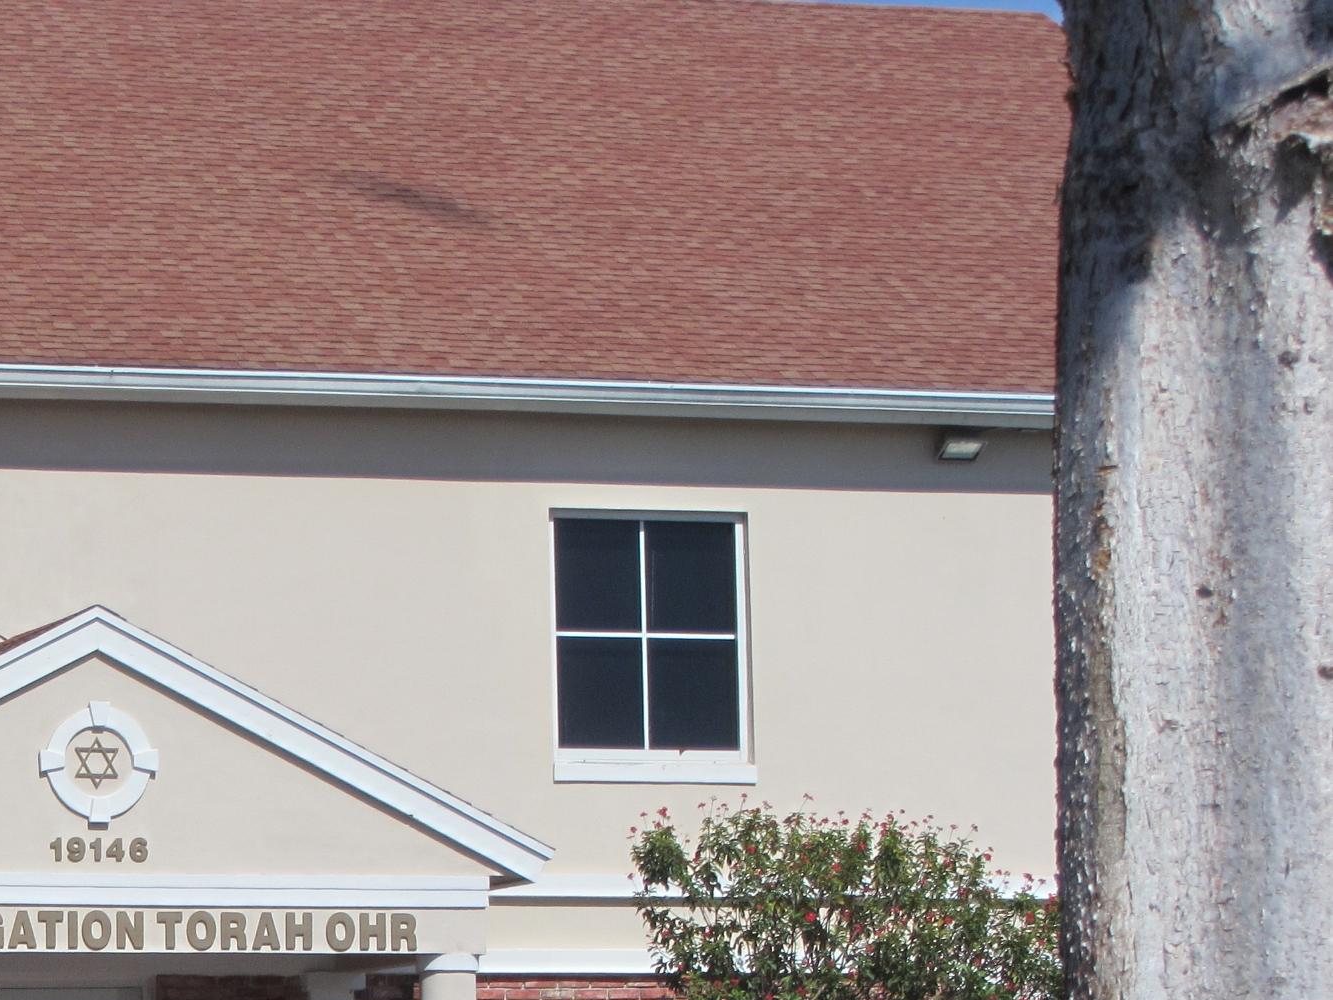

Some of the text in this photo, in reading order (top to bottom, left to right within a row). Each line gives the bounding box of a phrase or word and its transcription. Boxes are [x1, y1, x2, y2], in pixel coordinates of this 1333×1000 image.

[50, 837, 148, 863] 19146
[156, 910, 313, 951] TORAH
[325, 912, 418, 952] OHR
